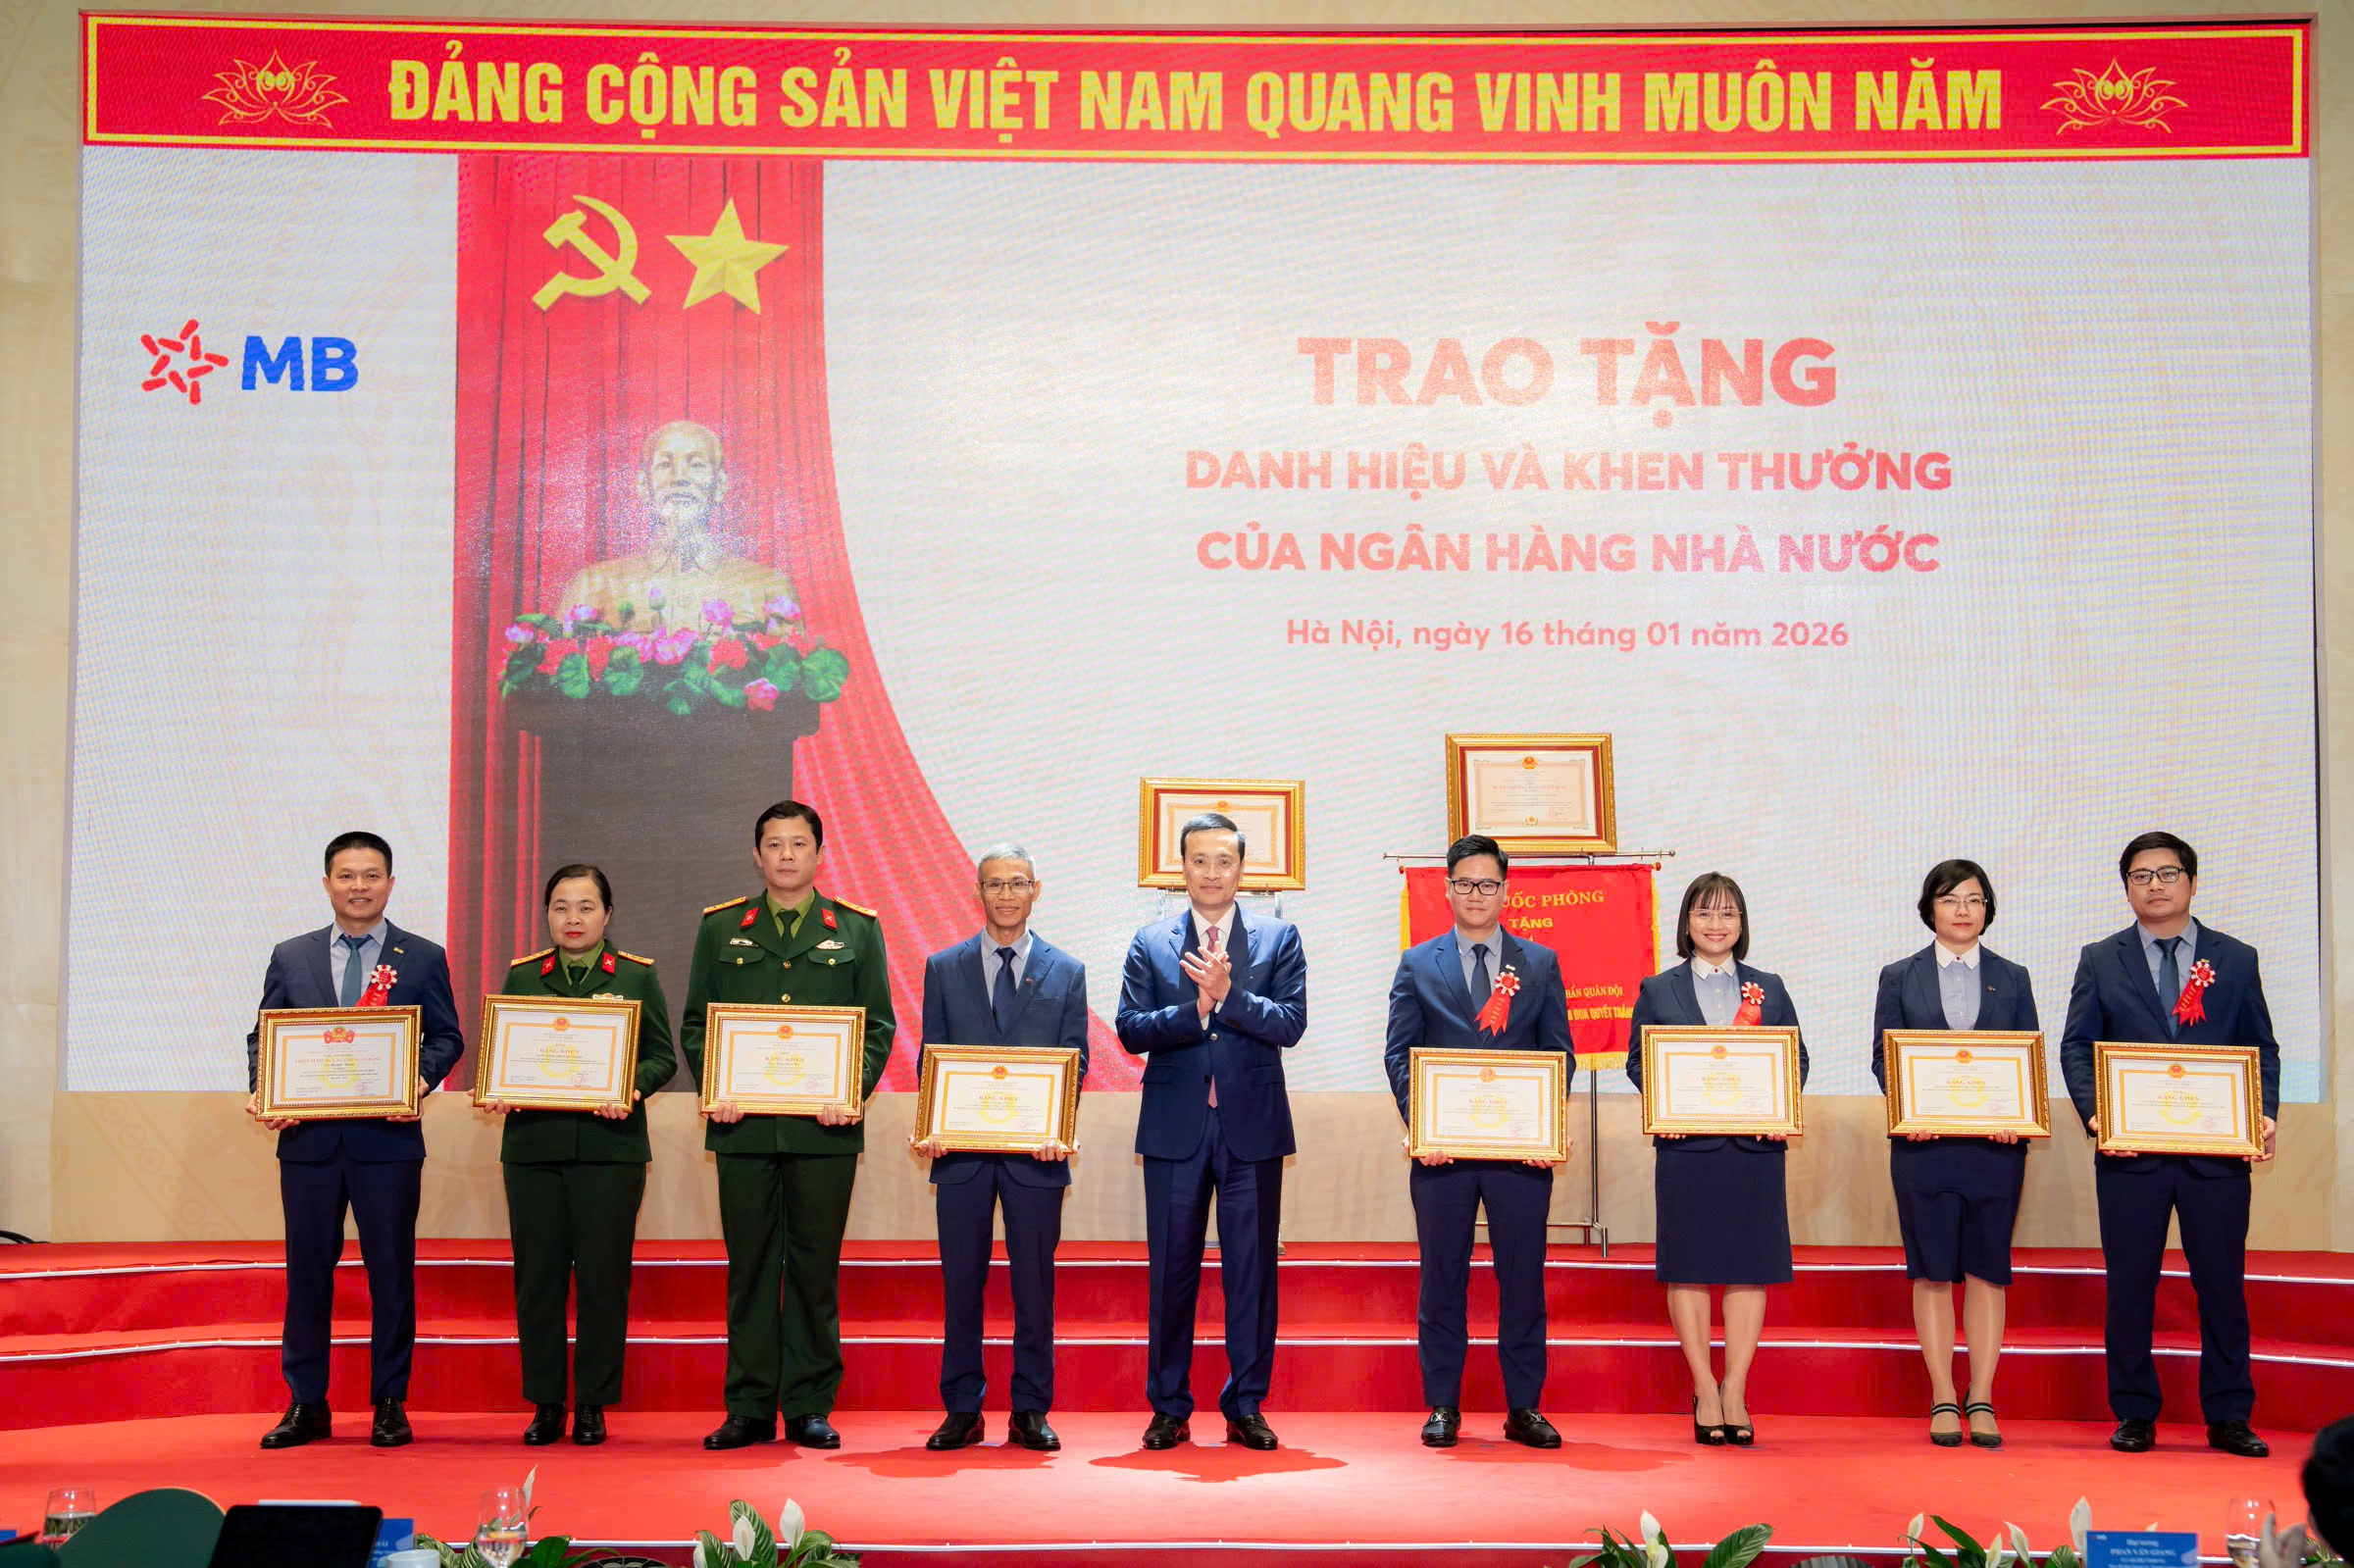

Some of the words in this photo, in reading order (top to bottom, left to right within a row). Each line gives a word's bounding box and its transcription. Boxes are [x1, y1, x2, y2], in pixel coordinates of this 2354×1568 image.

[389, 40, 562, 123] ĐẢNG
[588, 53, 756, 138] CỘNG
[780, 47, 907, 127] SẢN
[929, 57, 1058, 143] VIỆT
[1081, 71, 1222, 131] NAM
[1247, 72, 1453, 139] QUANG
[1475, 73, 1620, 132] VINH
[1645, 60, 1831, 131] MUÔN
[1856, 58, 2001, 129] NĂM
[241, 335, 359, 392] MB
[1298, 337, 1555, 405] TRAO
[1581, 322, 1837, 429] TẶNG
[1186, 451, 1332, 490] DANH
[1347, 443, 1465, 501] HIỆU
[1481, 443, 1549, 490] VÀ
[1564, 452, 1704, 491] KHEN
[1718, 441, 1953, 491] THƯỞNG
[1197, 522, 1305, 572] CỦA
[1320, 524, 1470, 573] NGÂN
[1486, 525, 1637, 574] HÀNG
[1653, 525, 1765, 573] NHÀ
[1779, 524, 1941, 574] NƯỚC
[1287, 620, 1330, 644] Hà
[1342, 620, 1403, 652] Nội,
[1413, 622, 1491, 651] ngày
[1501, 622, 1534, 645] 16
[1544, 620, 1637, 652] tháng
[1648, 622, 1680, 646] 01
[1692, 622, 1762, 646] năm
[1773, 622, 1850, 647] 2026
[1502, 890, 1536, 908] UỐC
[1541, 889, 1605, 907] PHÒNG
